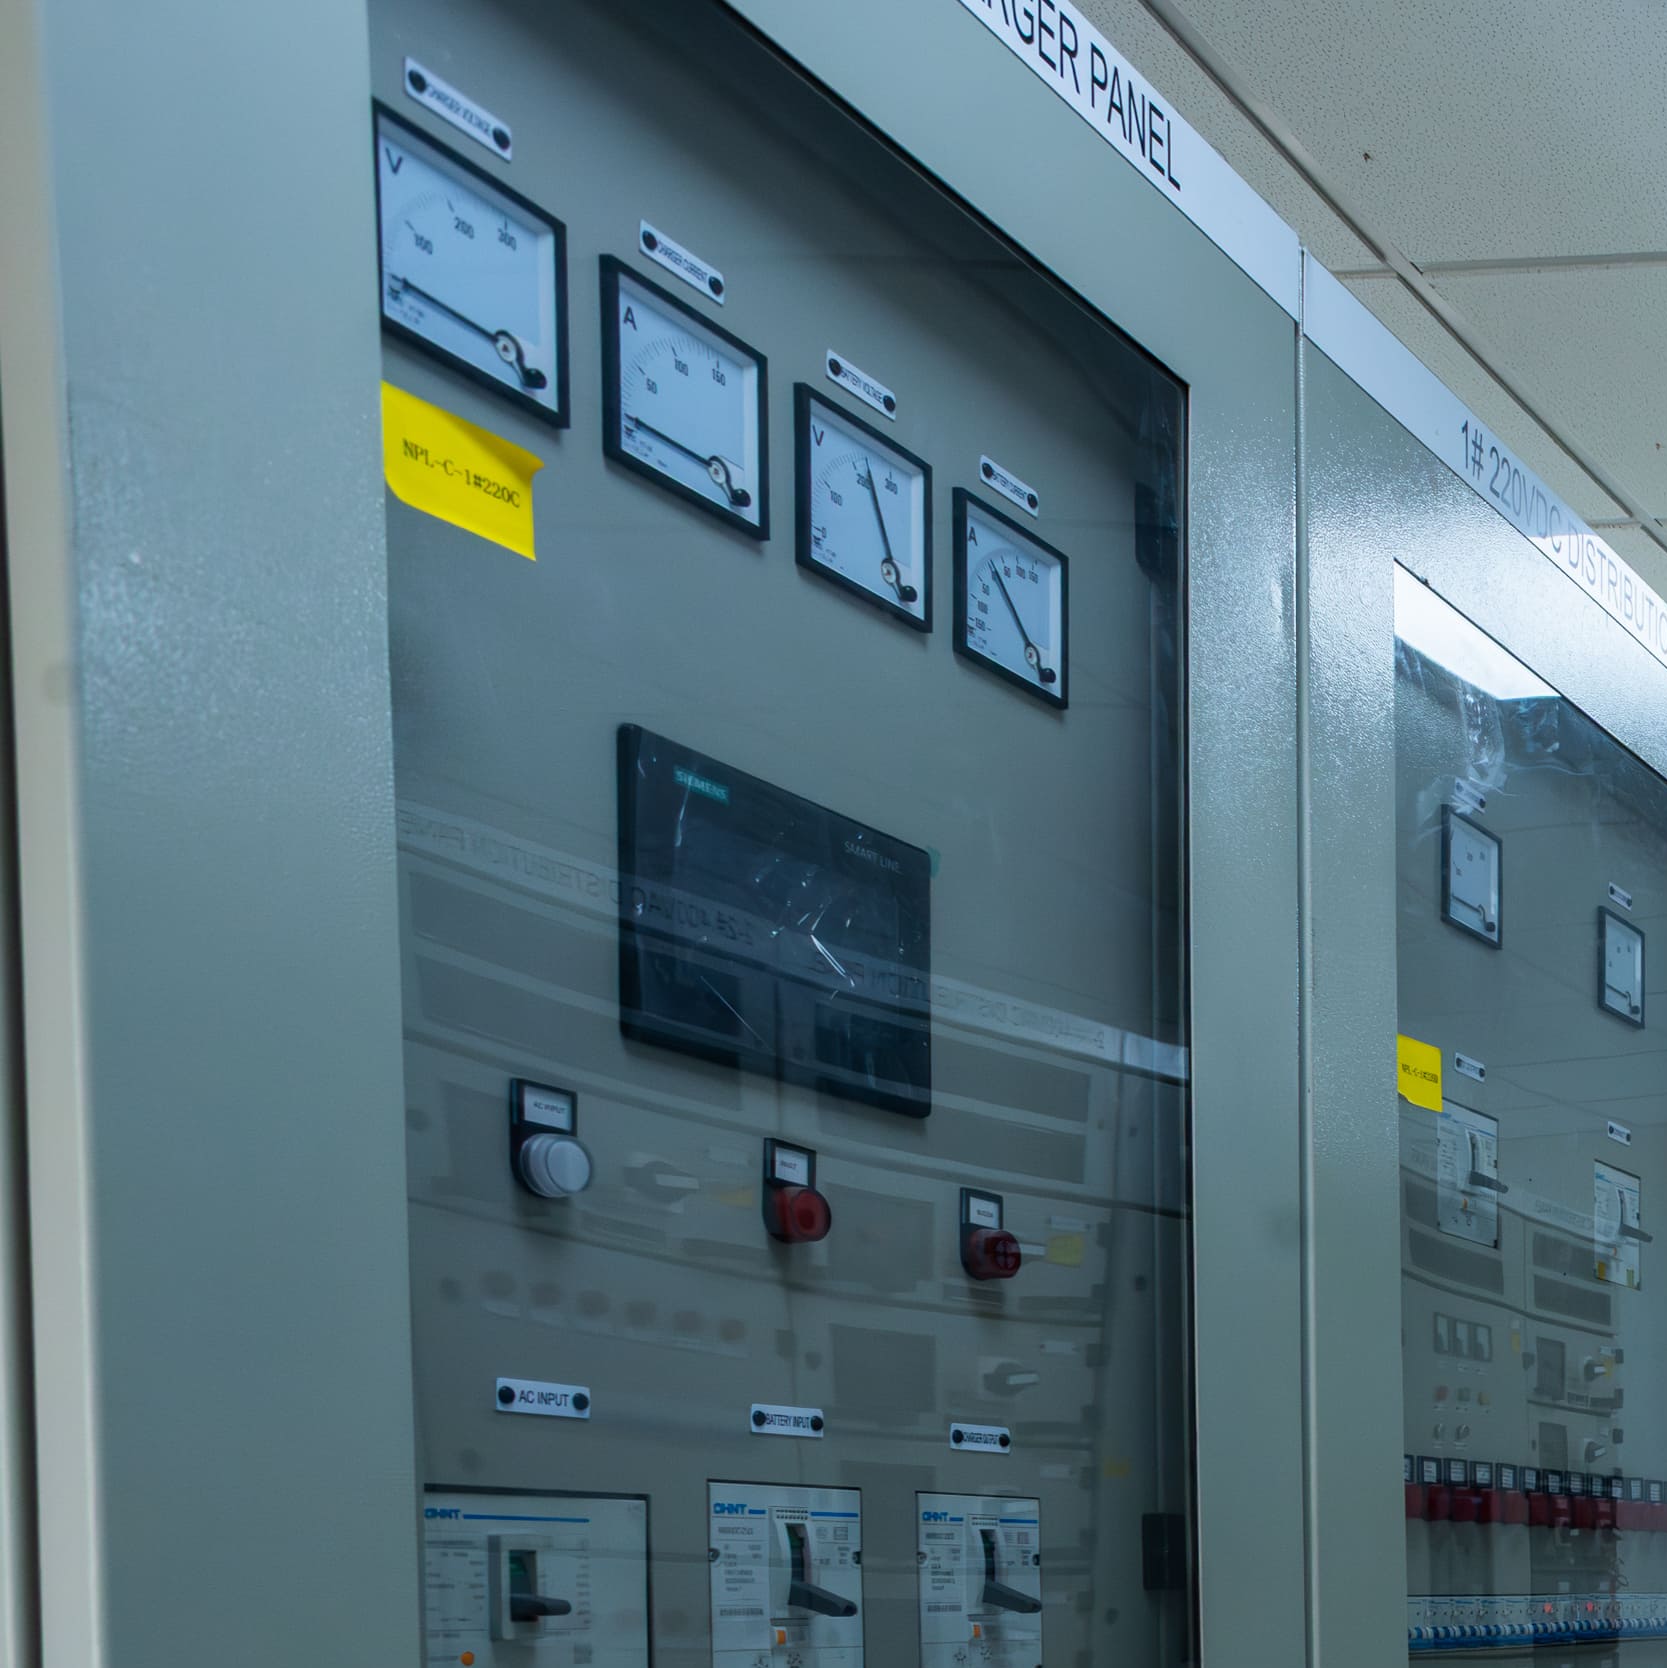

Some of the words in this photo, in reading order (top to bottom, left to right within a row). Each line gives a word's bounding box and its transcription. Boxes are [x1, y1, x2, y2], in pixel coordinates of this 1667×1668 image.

[1090, 41, 1181, 191] PANEL
[385, 147, 404, 175] V
[454, 215, 475, 240] 200
[497, 225, 517, 251] 300
[623, 305, 638, 332] A
[674, 358, 689, 377] 100
[711, 367, 726, 387] 150
[646, 377, 658, 395] 50
[812, 423, 825, 447] V
[1461, 419, 1484, 481] 1#
[1489, 445, 1562, 554] 220VDC
[968, 525, 978, 547] A
[675, 770, 729, 800] SIEMENS
[844, 840, 879, 864] SMART
[880, 855, 901, 874] LINE
[519, 1390, 535, 1404] AC
[536, 1391, 570, 1408] INPUT
[766, 1412, 792, 1428] BATTERY
[792, 1415, 811, 1430] INPUT
[713, 1502, 748, 1515] CHNT
